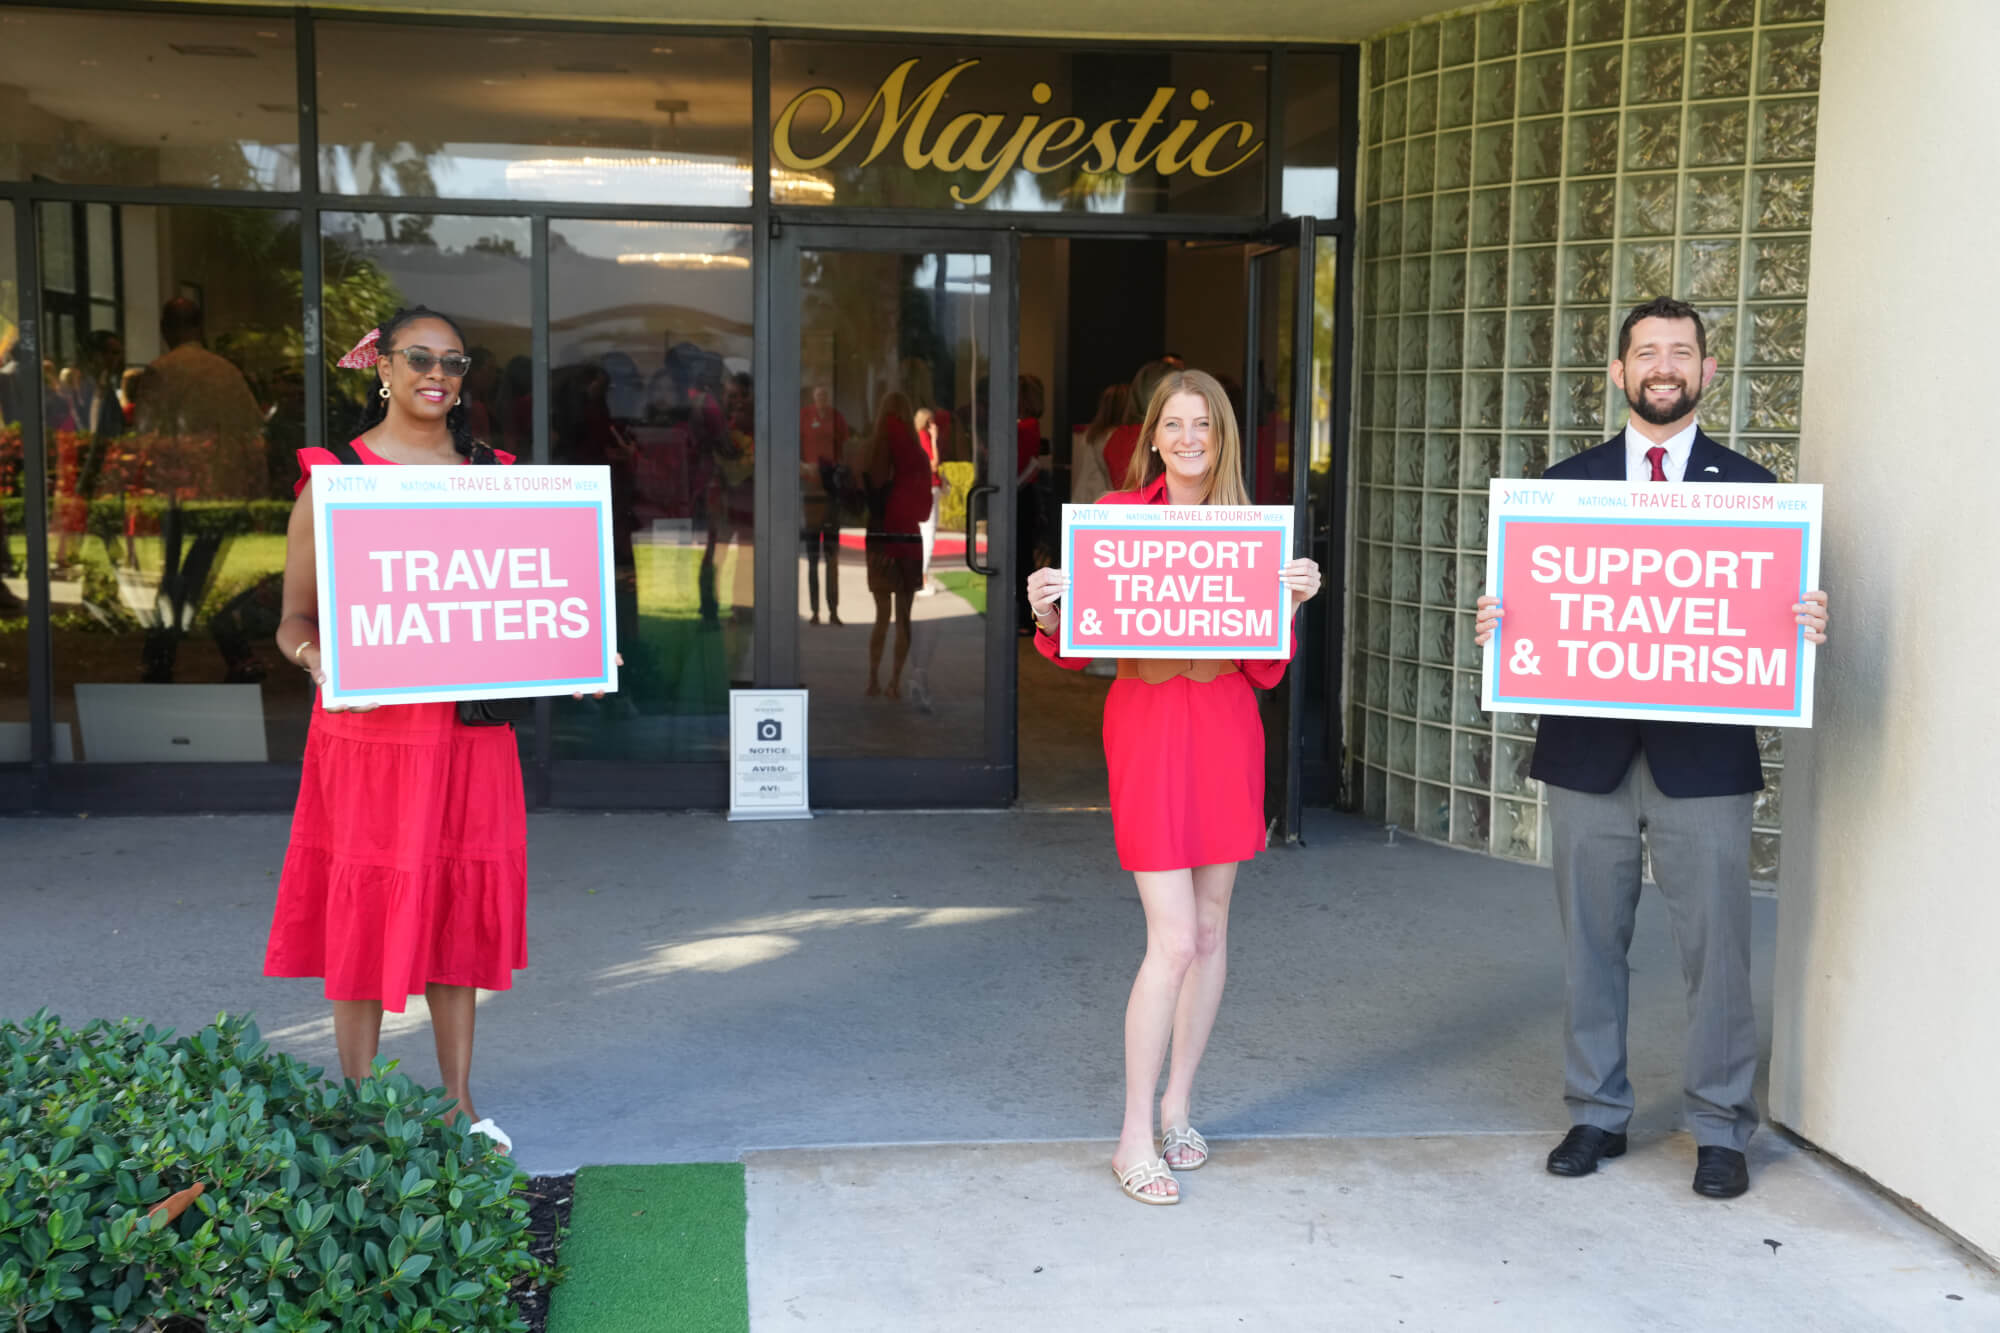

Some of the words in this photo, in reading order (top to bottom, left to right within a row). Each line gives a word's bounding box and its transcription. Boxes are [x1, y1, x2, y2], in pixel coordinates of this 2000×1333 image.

[772, 57, 1264, 204] Majestic
[401, 481, 448, 491] NATIONAL
[450, 477, 500, 491] TRAVEL
[503, 477, 513, 491] &
[514, 476, 573, 491] TOURISM
[574, 480, 599, 491] WEEK
[1578, 496, 1628, 507] NATIONAL
[1631, 492, 1688, 508] TRAVEL
[1691, 493, 1701, 508] &
[1704, 494, 1774, 510] TOURISM
[1777, 500, 1808, 511] WEEK
[1126, 513, 1161, 521] NATIONAL
[1163, 510, 1203, 521] TRAVEL
[1205, 510, 1213, 521] &
[1215, 510, 1262, 521] TOURISM
[369, 548, 568, 592] TRAVEL
[1093, 540, 1263, 569] SUPPORT
[1530, 545, 1774, 589] SUPPORT
[1107, 574, 1245, 603] TRAVEL
[351, 597, 590, 647] MATTERS
[1079, 608, 1103, 635] &
[1113, 608, 1273, 637] TOURISM
[1550, 593, 1746, 637] TRAVEL
[1509, 638, 1542, 676] &
[1557, 639, 1787, 686] TOURISM
